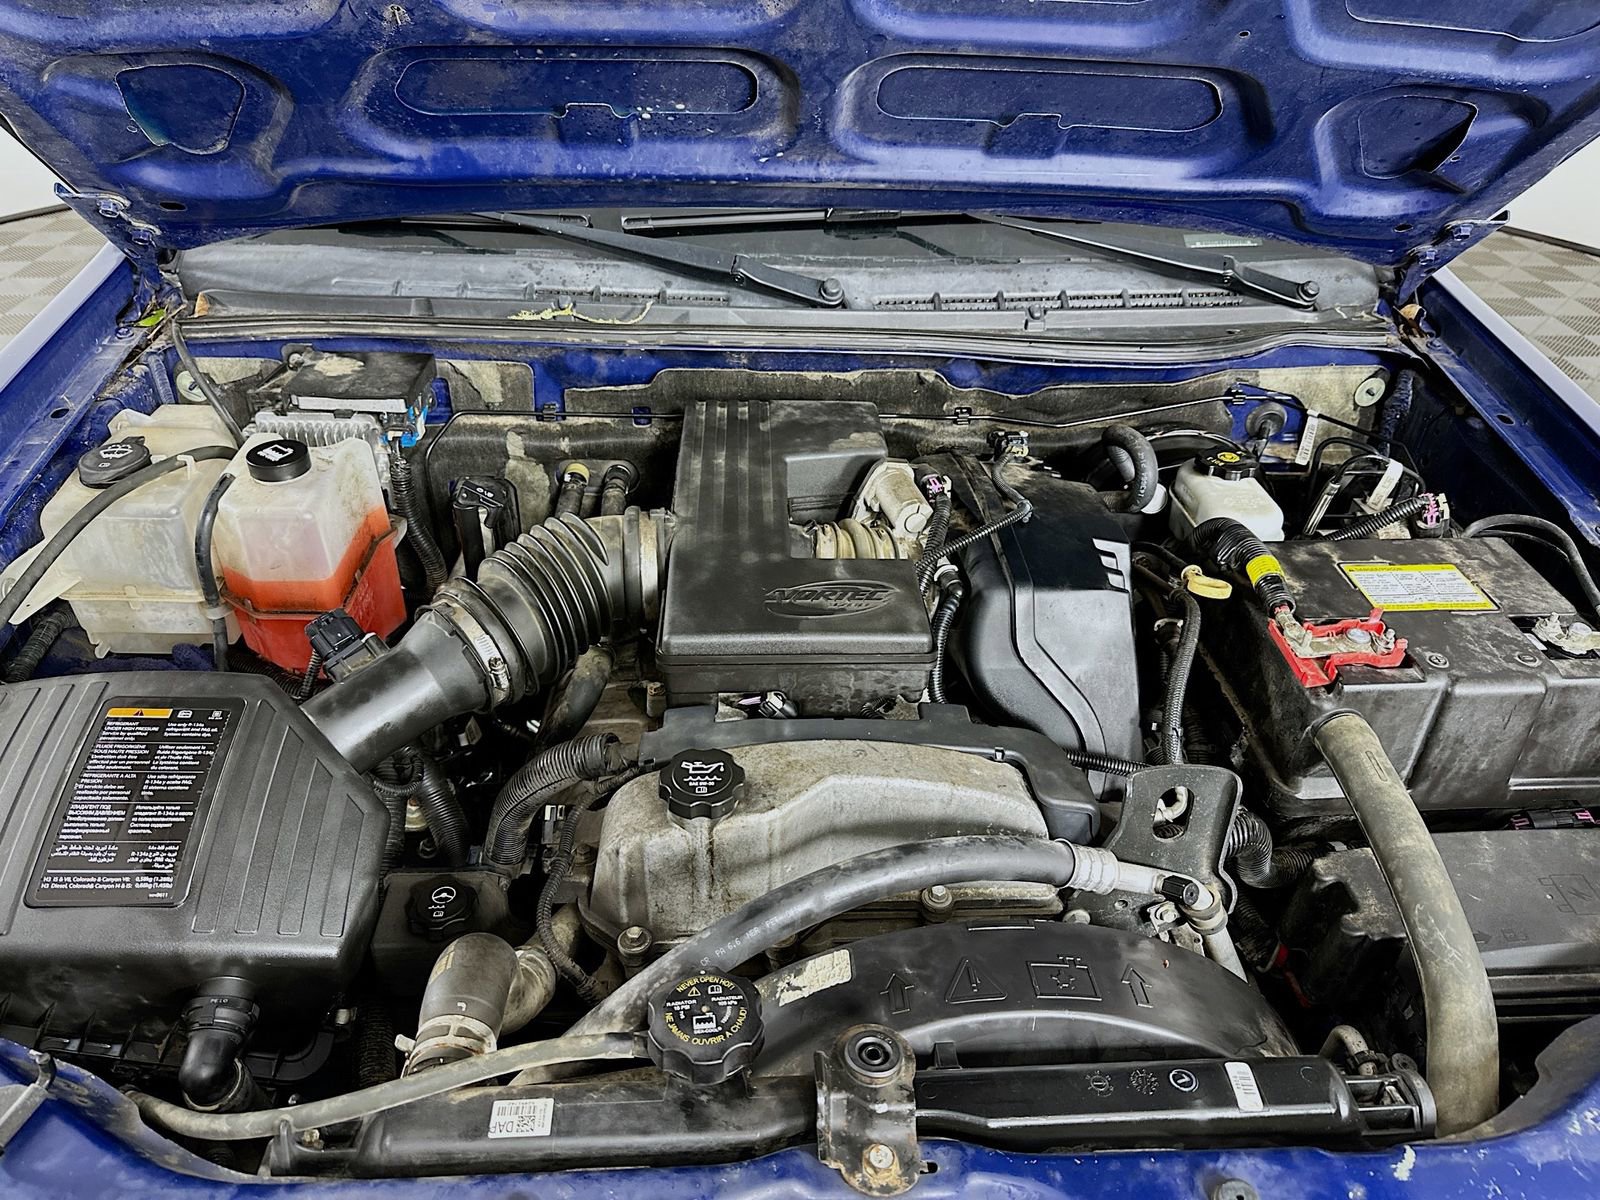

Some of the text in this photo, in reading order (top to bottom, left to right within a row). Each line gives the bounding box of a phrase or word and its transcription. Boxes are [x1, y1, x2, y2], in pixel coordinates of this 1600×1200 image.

[773, 588, 891, 602] VORTEC
[715, 948, 726, 957] PA
[676, 979, 700, 993] NEVER
[719, 978, 735, 990] HOT!
[667, 999, 696, 1007] RADIATOR
[665, 1012, 674, 1023] NE
[731, 1007, 747, 1033] CHAUD!
[668, 1023, 690, 1042] JAMAIS
[692, 1035, 725, 1045] OUVRIR
